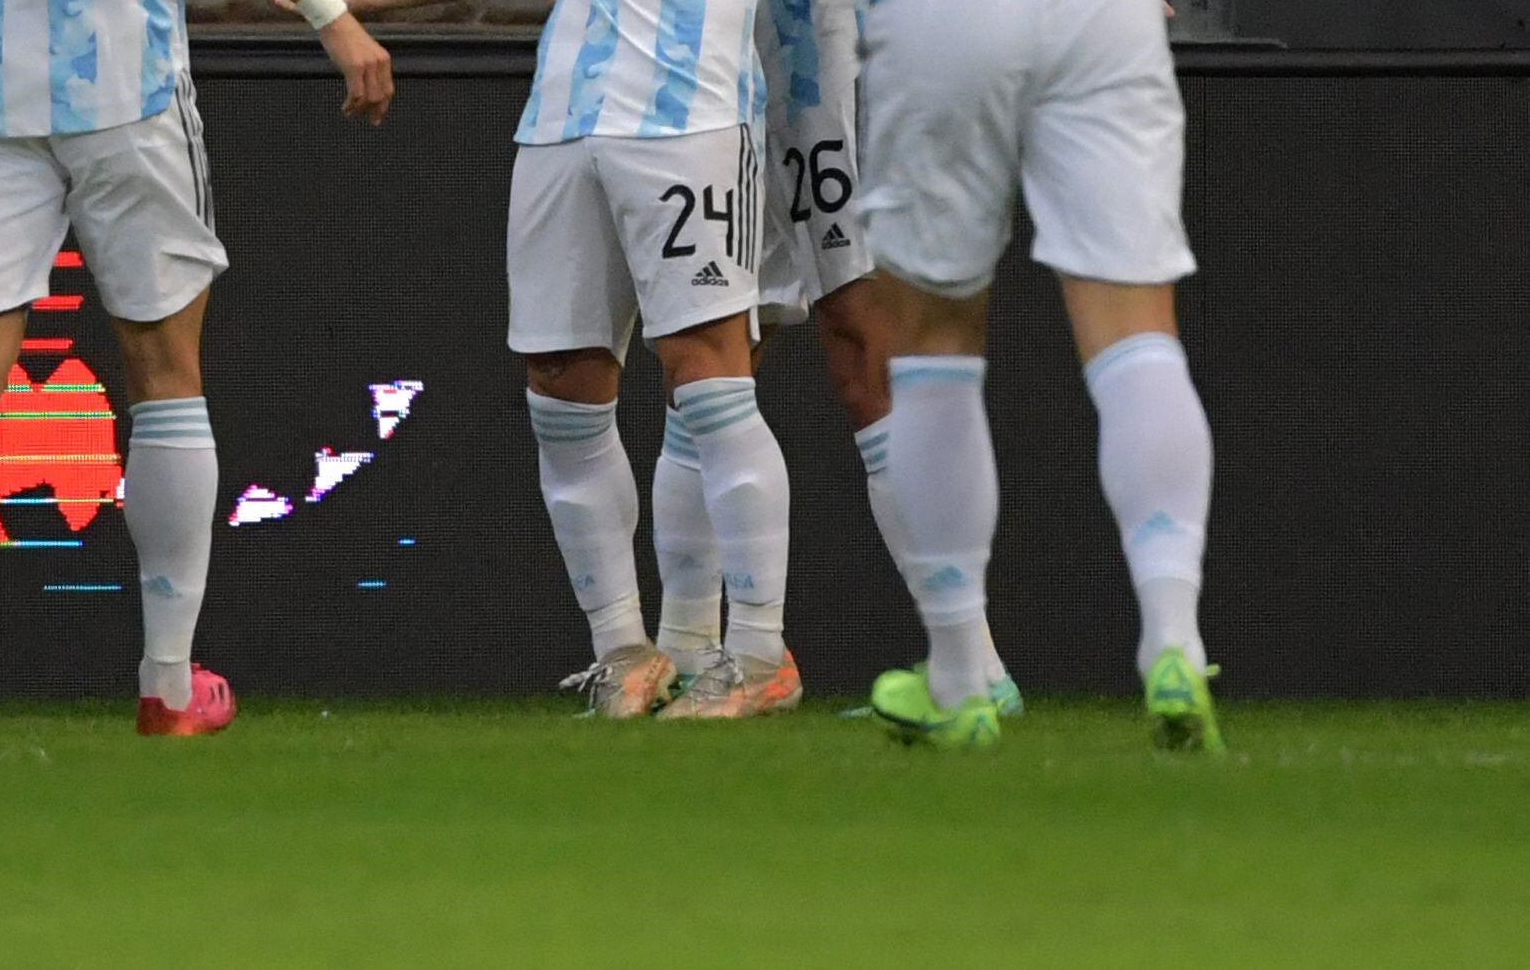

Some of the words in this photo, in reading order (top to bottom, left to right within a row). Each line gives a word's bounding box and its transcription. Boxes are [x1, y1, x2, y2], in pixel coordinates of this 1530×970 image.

[782, 139, 852, 223] 26
[658, 184, 734, 259] 24
[691, 276, 729, 287] adidas
